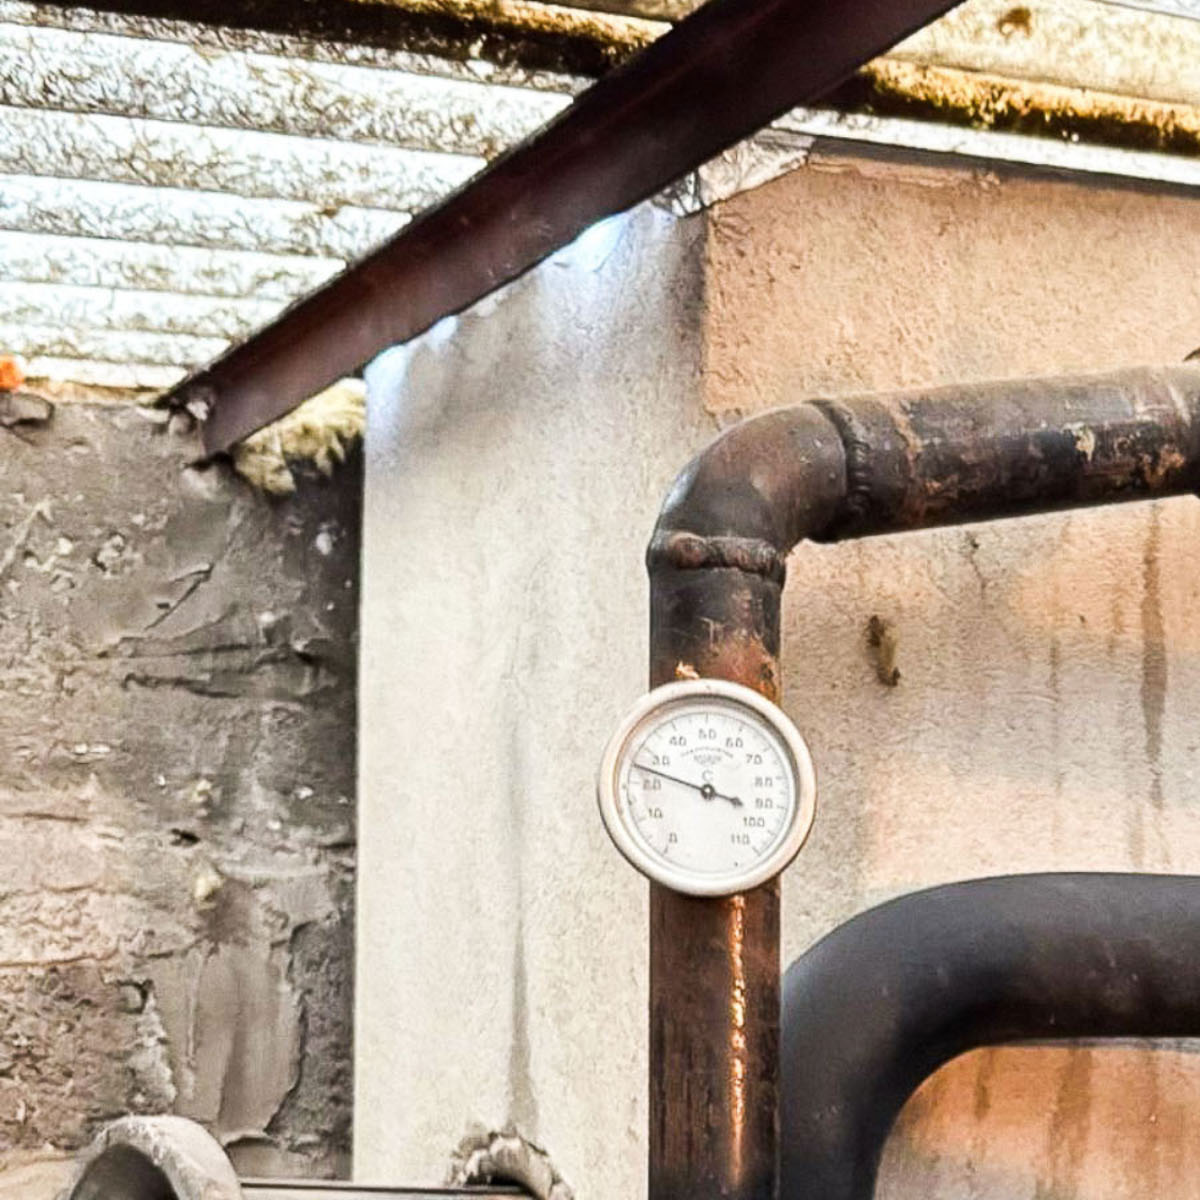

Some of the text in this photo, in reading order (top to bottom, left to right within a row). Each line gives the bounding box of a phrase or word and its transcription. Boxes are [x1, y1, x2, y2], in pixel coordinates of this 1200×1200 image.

[698, 728, 716, 739] 50
[669, 736, 687, 747] 40
[725, 737, 744, 748] 60
[652, 754, 671, 766] 30
[745, 754, 763, 765] 70
[642, 779, 662, 791] 20
[754, 776, 773, 788] 80
[755, 798, 773, 810] 90
[648, 807, 664, 819] 10
[742, 816, 766, 828] 100
[668, 832, 678, 844] 0
[730, 834, 750, 846] 110
